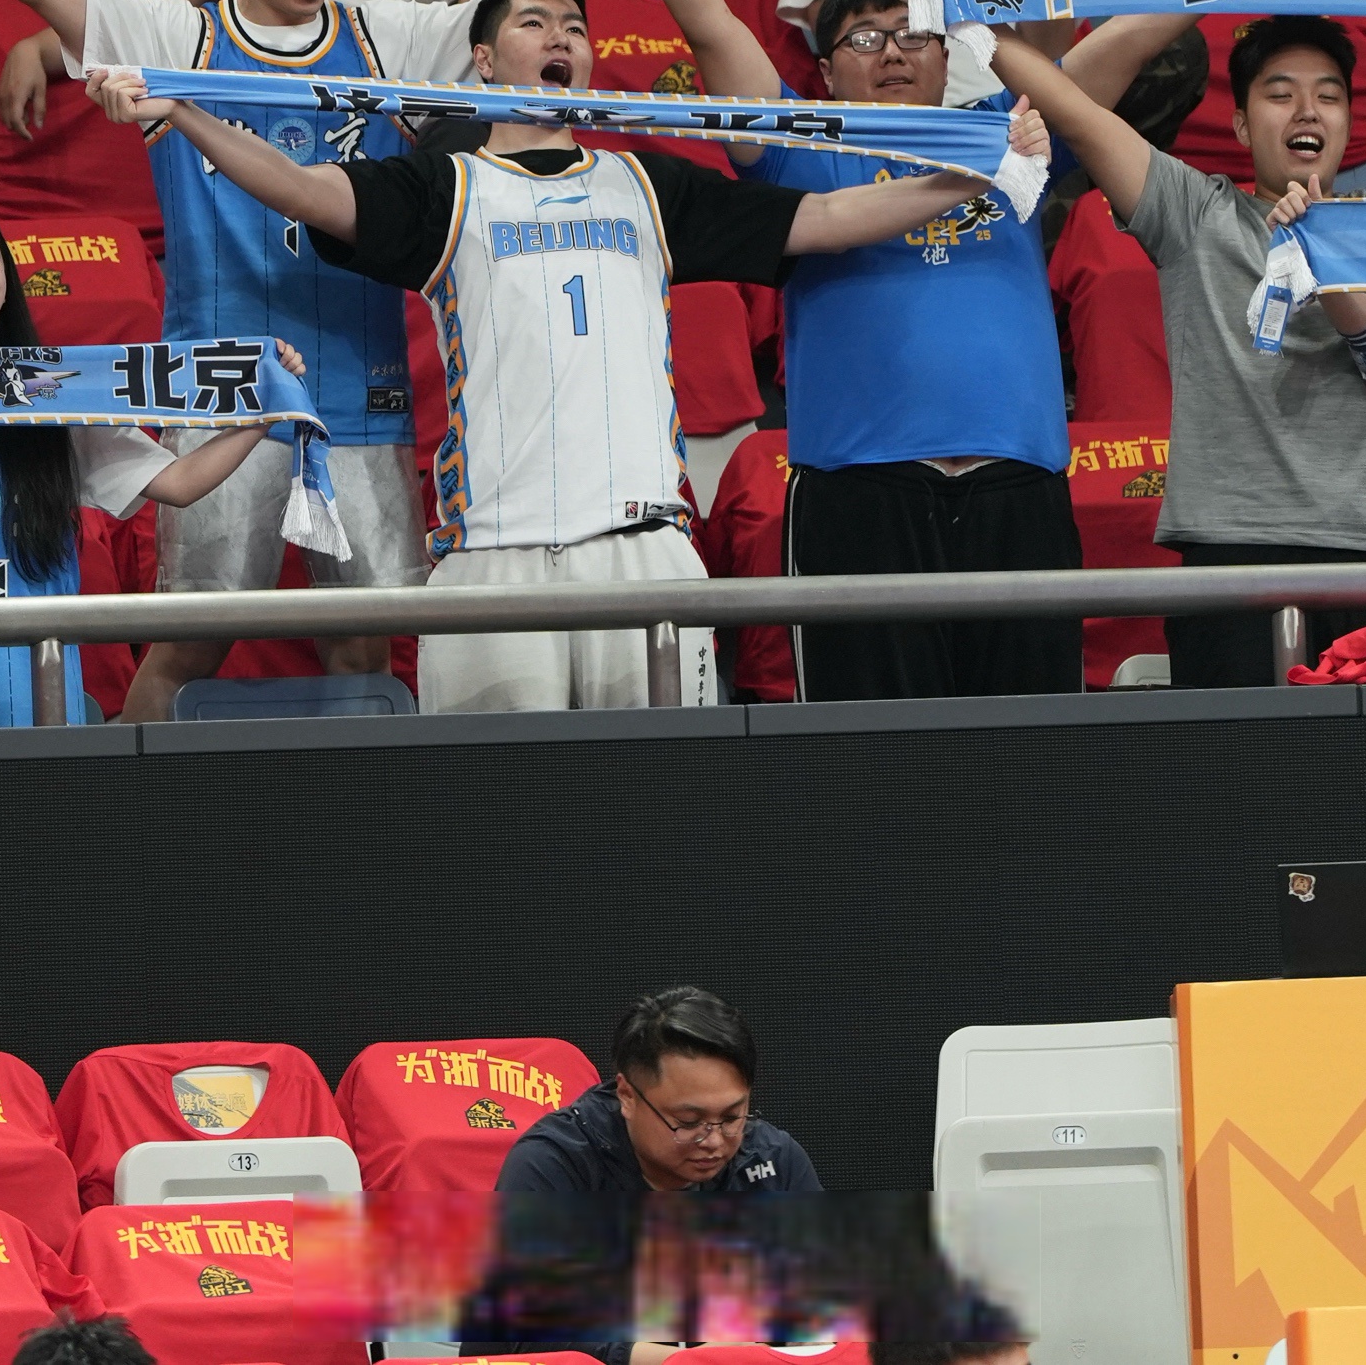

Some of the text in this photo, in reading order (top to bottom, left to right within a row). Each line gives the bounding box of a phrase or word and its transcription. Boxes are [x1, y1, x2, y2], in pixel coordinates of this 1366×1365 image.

[488, 217, 640, 263] BEIJING
[921, 241, 950, 266] 他
[562, 274, 589, 336] 1
[113, 337, 265, 417] 北京
[1062, 1128, 1076, 1144] 11
[237, 1155, 253, 1171] 13
[745, 1160, 777, 1183] HH
